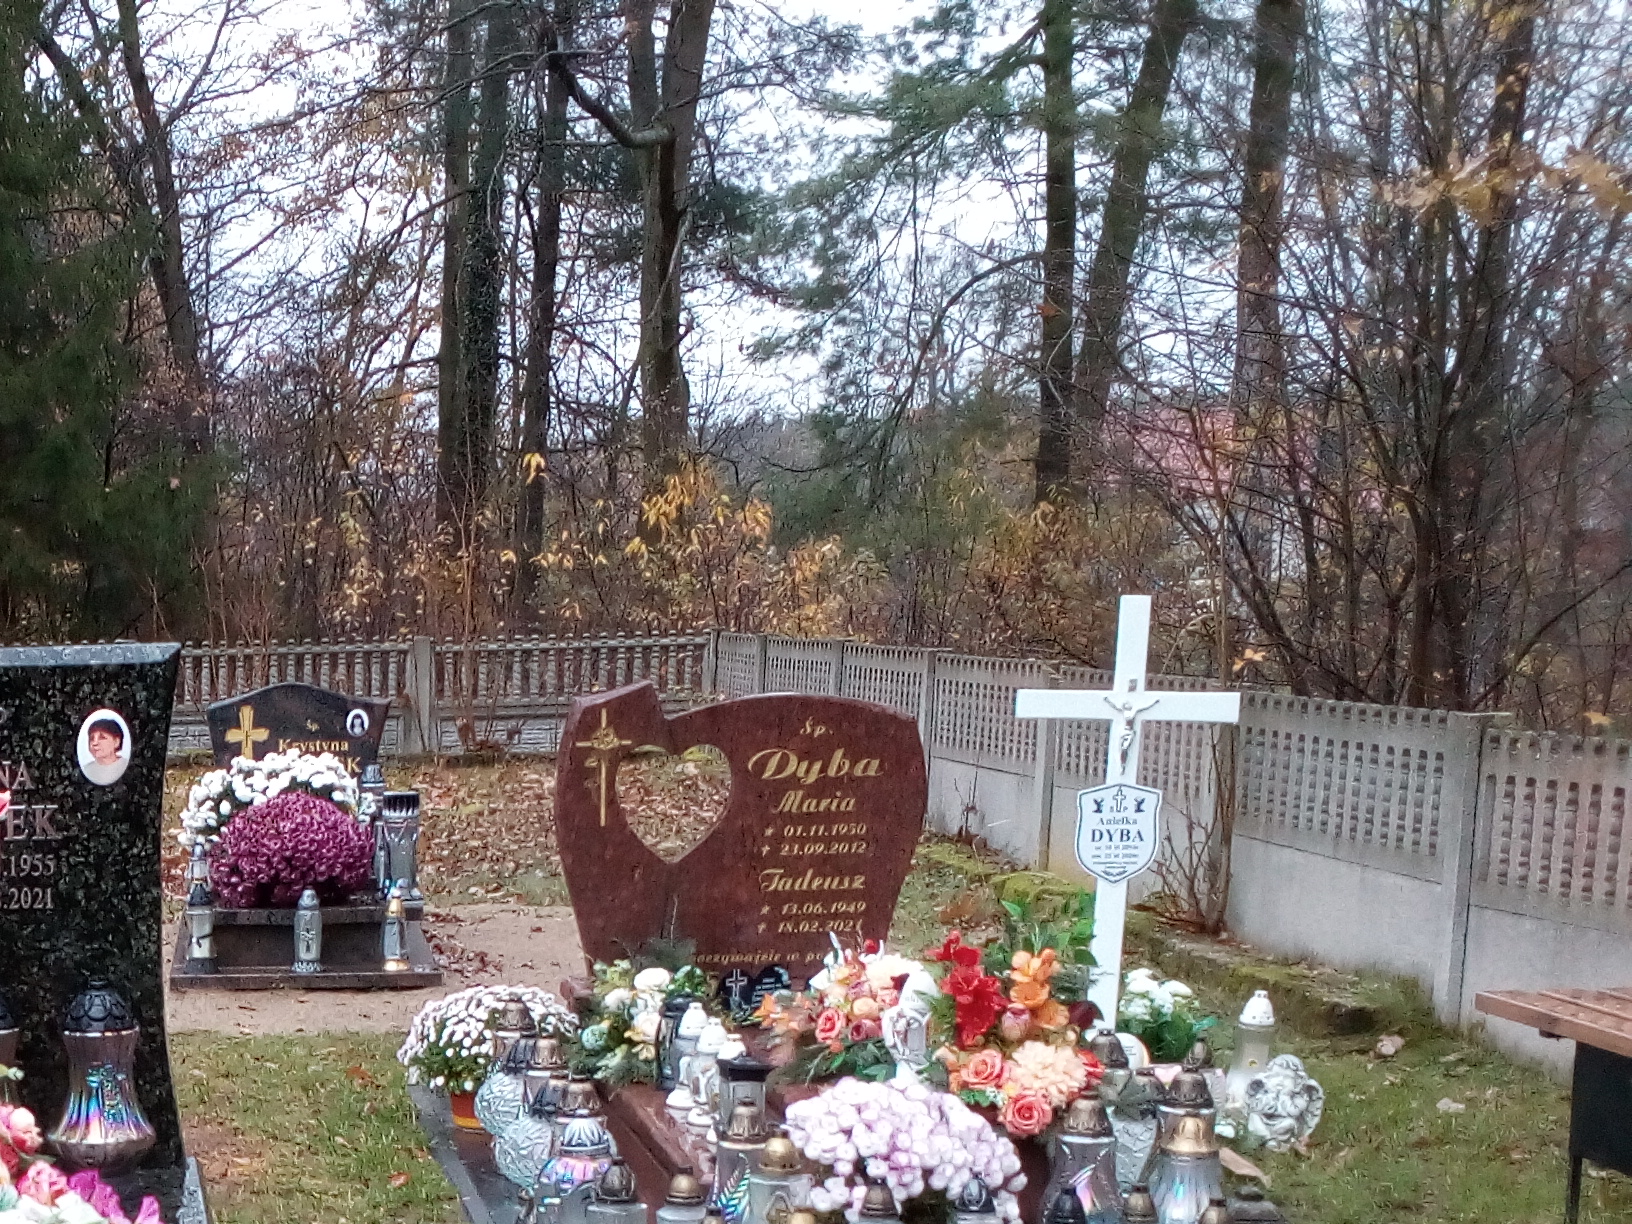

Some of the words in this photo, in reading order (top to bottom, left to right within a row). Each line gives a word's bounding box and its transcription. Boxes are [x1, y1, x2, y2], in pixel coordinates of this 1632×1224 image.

[748, 747, 885, 785] Dyba
[771, 789, 856, 813] Maria
[1091, 828, 1145, 843] DYBA
[759, 868, 866, 891] Tadeusz
